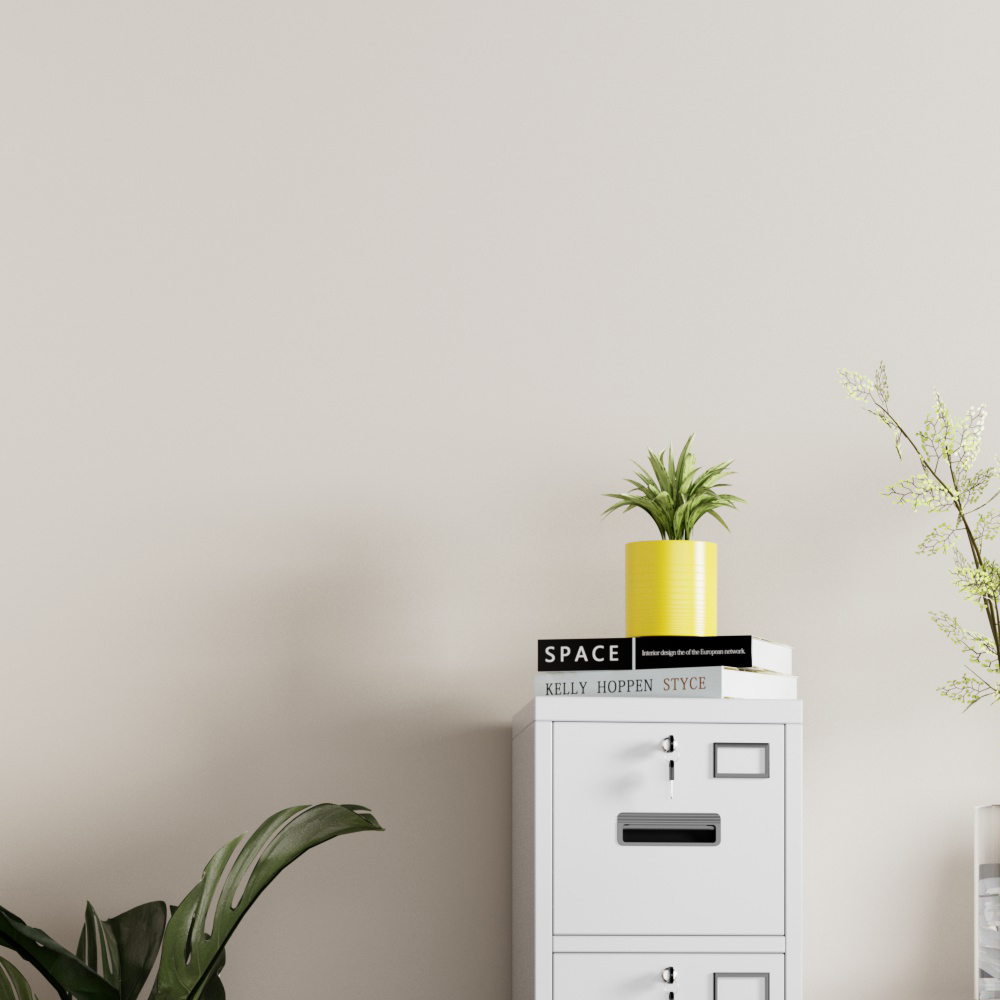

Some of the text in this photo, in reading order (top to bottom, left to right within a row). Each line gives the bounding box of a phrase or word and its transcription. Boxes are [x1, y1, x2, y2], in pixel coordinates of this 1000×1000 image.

[544, 644, 619, 663] SPACE
[641, 649, 660, 657] Interior
[660, 649, 677, 658] design
[685, 648, 692, 656] of
[692, 648, 700, 656] the
[700, 648, 724, 657] European
[724, 647, 746, 656] network.
[545, 676, 707, 696] KELLY HOPPEN STYCE
